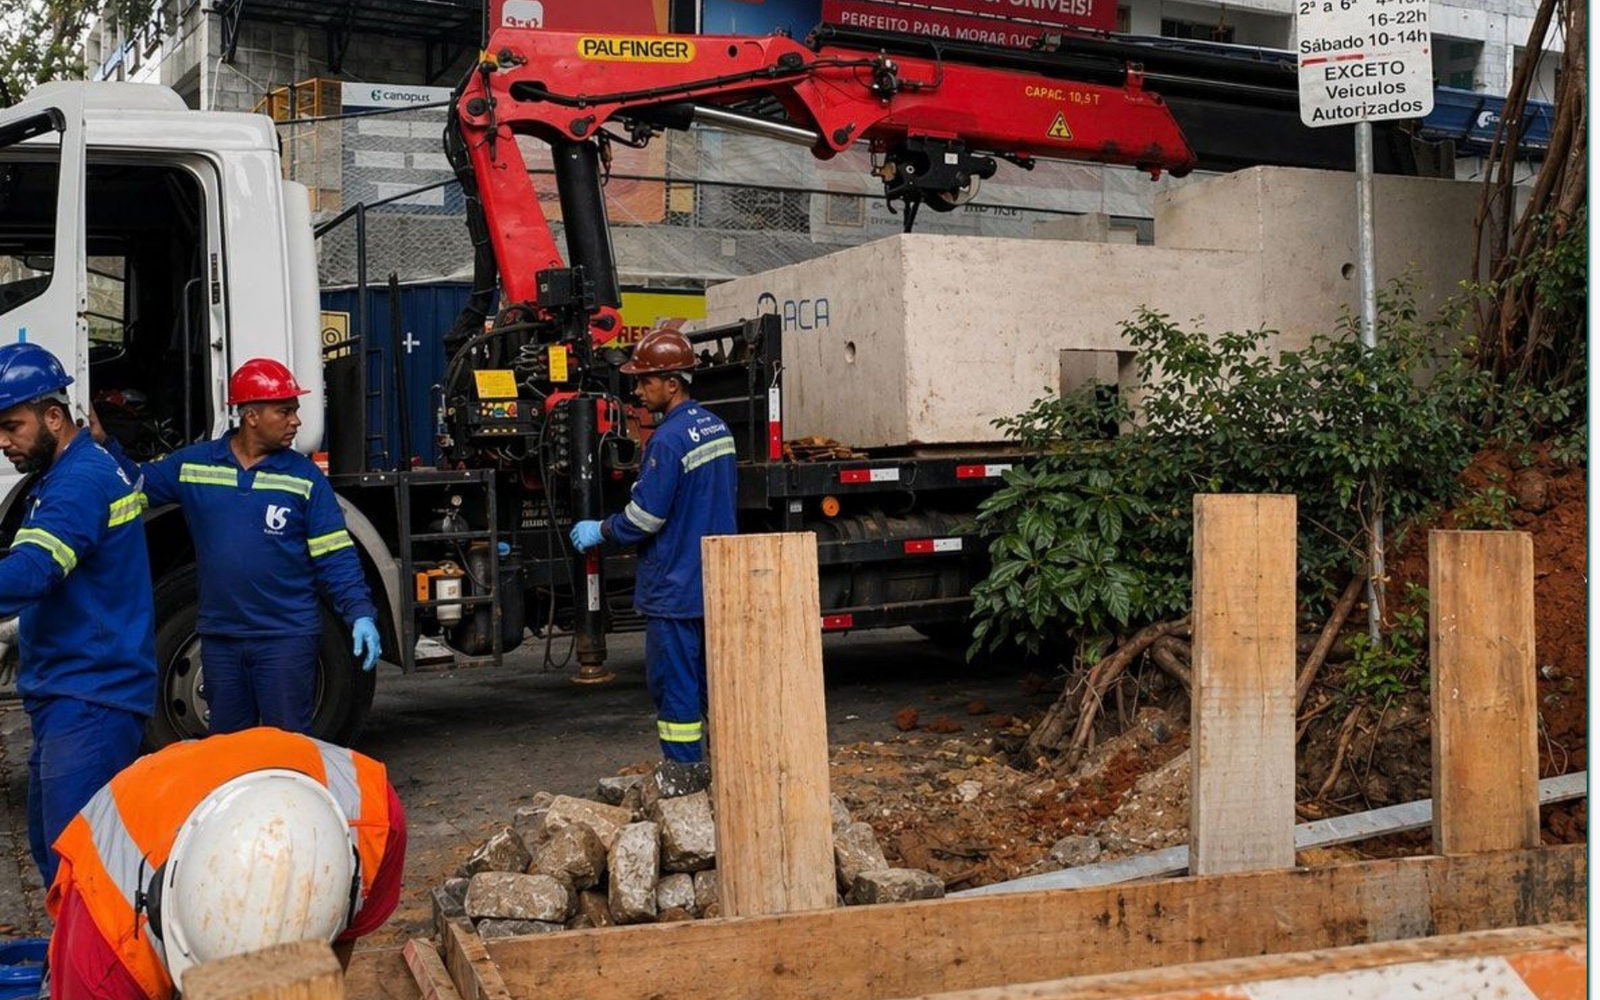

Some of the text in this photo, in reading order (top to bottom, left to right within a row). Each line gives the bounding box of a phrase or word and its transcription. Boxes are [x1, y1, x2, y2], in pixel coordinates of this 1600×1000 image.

[1323, 2, 1333, 13] a
[1368, 9, 1427, 27] 16-22h
[841, 11, 909, 32] PERFEITO
[913, 21, 951, 38] PARA
[956, 26, 1007, 46] MORAR
[583, 39, 689, 58] PALFINGER
[1300, 29, 1427, 54] Sábado 10-14h
[1325, 60, 1405, 81] EXCETO
[383, 90, 431, 103] canopus
[1093, 94, 1101, 105] T
[1312, 99, 1423, 122] Autorizados
